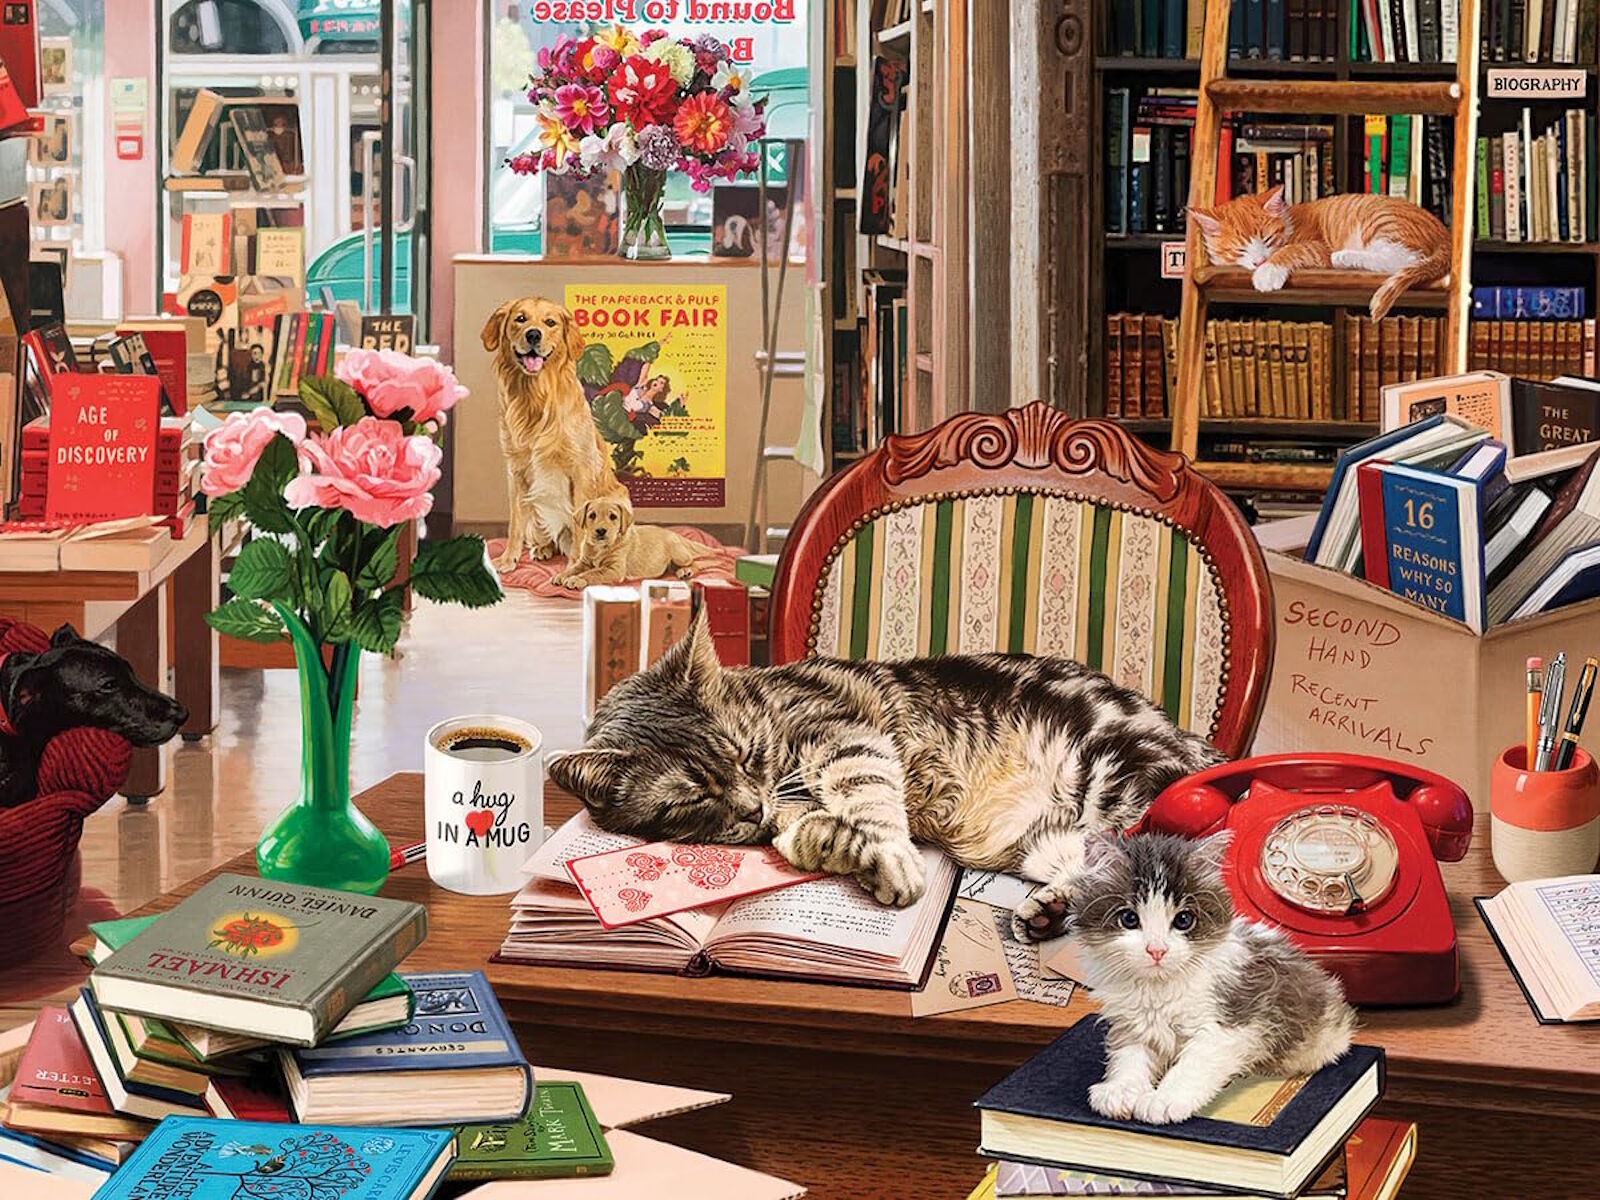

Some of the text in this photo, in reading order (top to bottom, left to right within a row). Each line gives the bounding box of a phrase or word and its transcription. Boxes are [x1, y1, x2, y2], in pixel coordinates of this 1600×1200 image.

[1494, 77, 1581, 92] BIOGRAPHY
[575, 294, 597, 306] THE
[601, 295, 673, 305] PAPERBACK
[675, 294, 686, 305] &
[372, 320, 403, 332] THE
[574, 308, 718, 328] BOOK FAIR
[77, 406, 108, 425] AGE
[1542, 405, 1570, 420] THE
[104, 428, 119, 443] OF
[1539, 424, 1591, 442] GREAT
[57, 446, 148, 465] DISCOVERY
[1403, 499, 1435, 529] 16
[1392, 543, 1457, 576] REASONS
[1399, 566, 1453, 594] WHY SO
[1404, 587, 1448, 612] MANY
[1284, 601, 1401, 646] SECOND
[1308, 636, 1371, 669] HAND
[1291, 674, 1379, 711] RECENT
[1308, 707, 1434, 755] ARRIVALS
[452, 780, 515, 827] a hug
[438, 821, 530, 849] IN A MUG
[228, 884, 296, 905] QUINN
[301, 897, 378, 920] DANIEL
[148, 952, 291, 990] ISHMAEL
[428, 1020, 488, 1035] DON
[375, 1043, 466, 1055] CERVANTES
[546, 1119, 577, 1152] MARK
[384, 1143, 416, 1175] LEWIS
